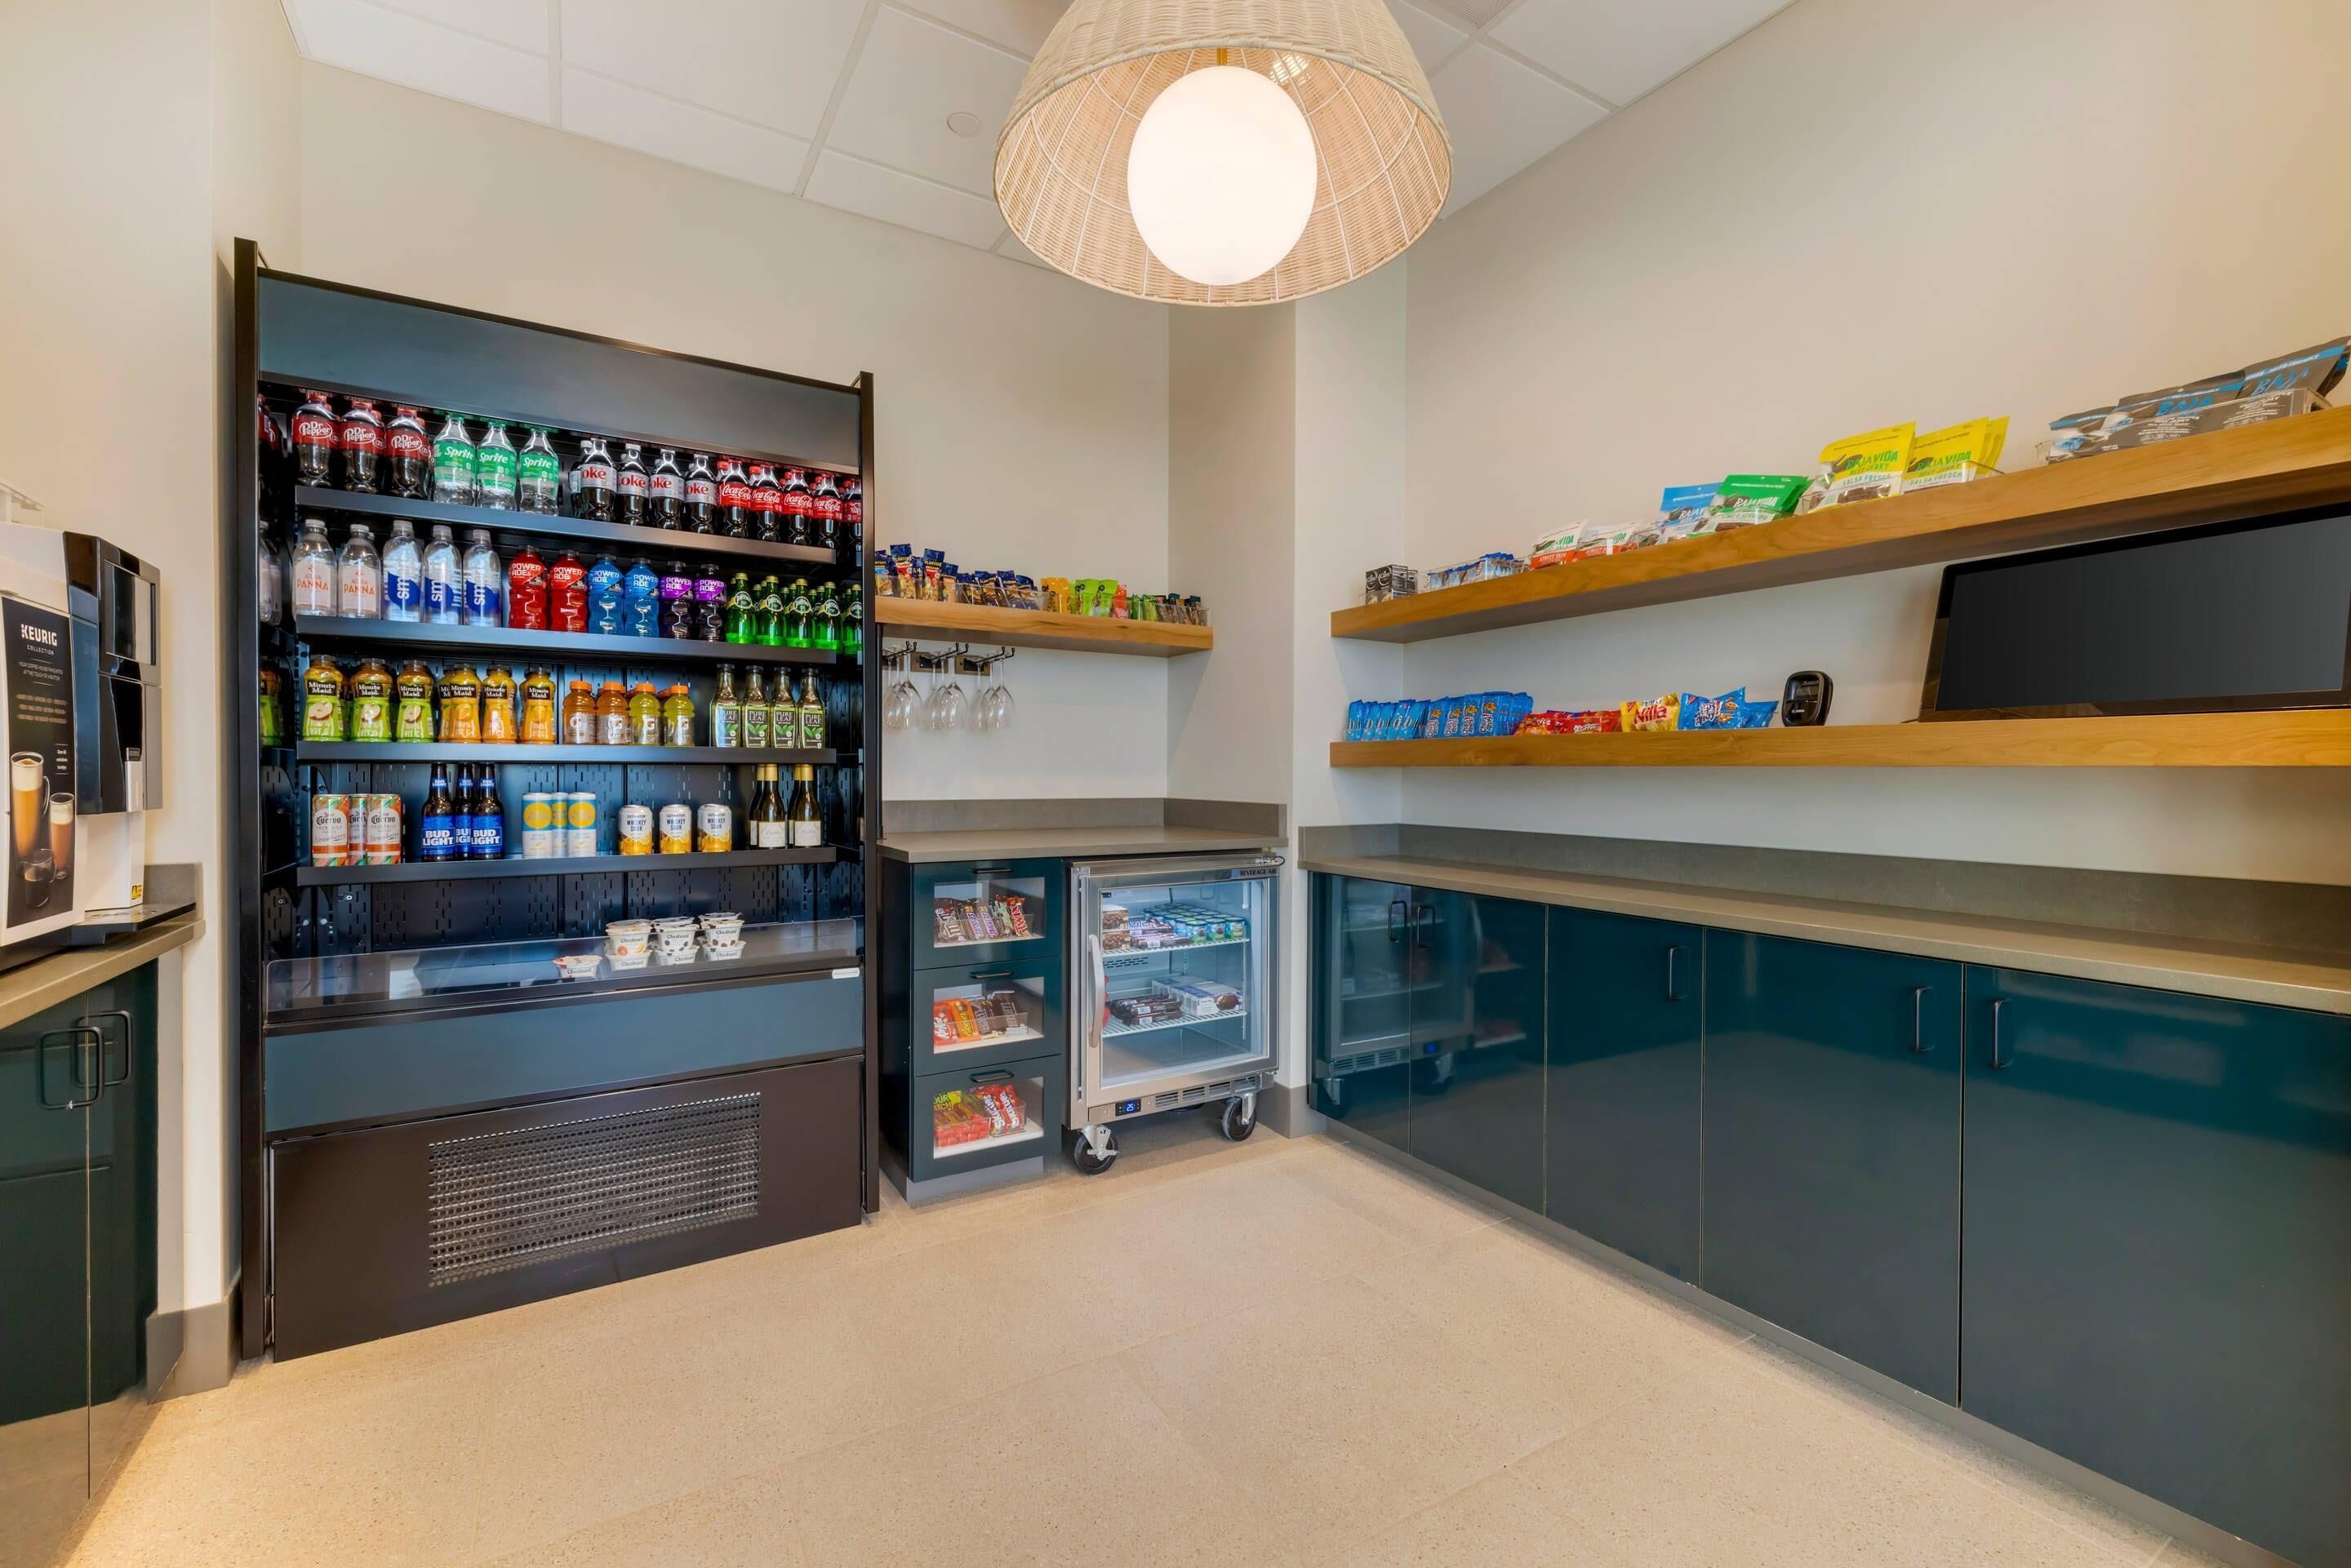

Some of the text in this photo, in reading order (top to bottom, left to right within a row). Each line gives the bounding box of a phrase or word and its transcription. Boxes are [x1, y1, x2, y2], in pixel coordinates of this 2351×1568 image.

[2156, 395, 2212, 416] BAJA
[310, 420, 323, 429] Dr
[302, 422, 331, 437] Pepper
[355, 427, 366, 435] Dr
[346, 429, 374, 442] Pepper
[402, 434, 413, 442] Dr
[393, 436, 420, 449] Pepper
[445, 446, 474, 460] Sprite
[1874, 449, 1898, 463] VIDA
[1945, 451, 1971, 462] VIDA
[479, 452, 509, 464] Sprite
[523, 457, 553, 469] Sprite
[512, 563, 540, 572] POWER
[553, 567, 582, 576] POWER
[593, 571, 620, 580] POWER
[633, 575, 659, 584] POWER
[297, 579, 328, 590] PANNA
[666, 577, 691, 586] POWER
[700, 580, 724, 588] POWER
[21, 624, 57, 646] KEURIG
[27, 644, 54, 655] COLLECTION
[316, 816, 341, 825] Cuervo
[371, 815, 396, 824] Cuervo
[425, 830, 450, 838] BUD
[473, 829, 496, 837] BUD
[423, 837, 454, 846] LIGHT
[471, 837, 500, 845] LIGHT
